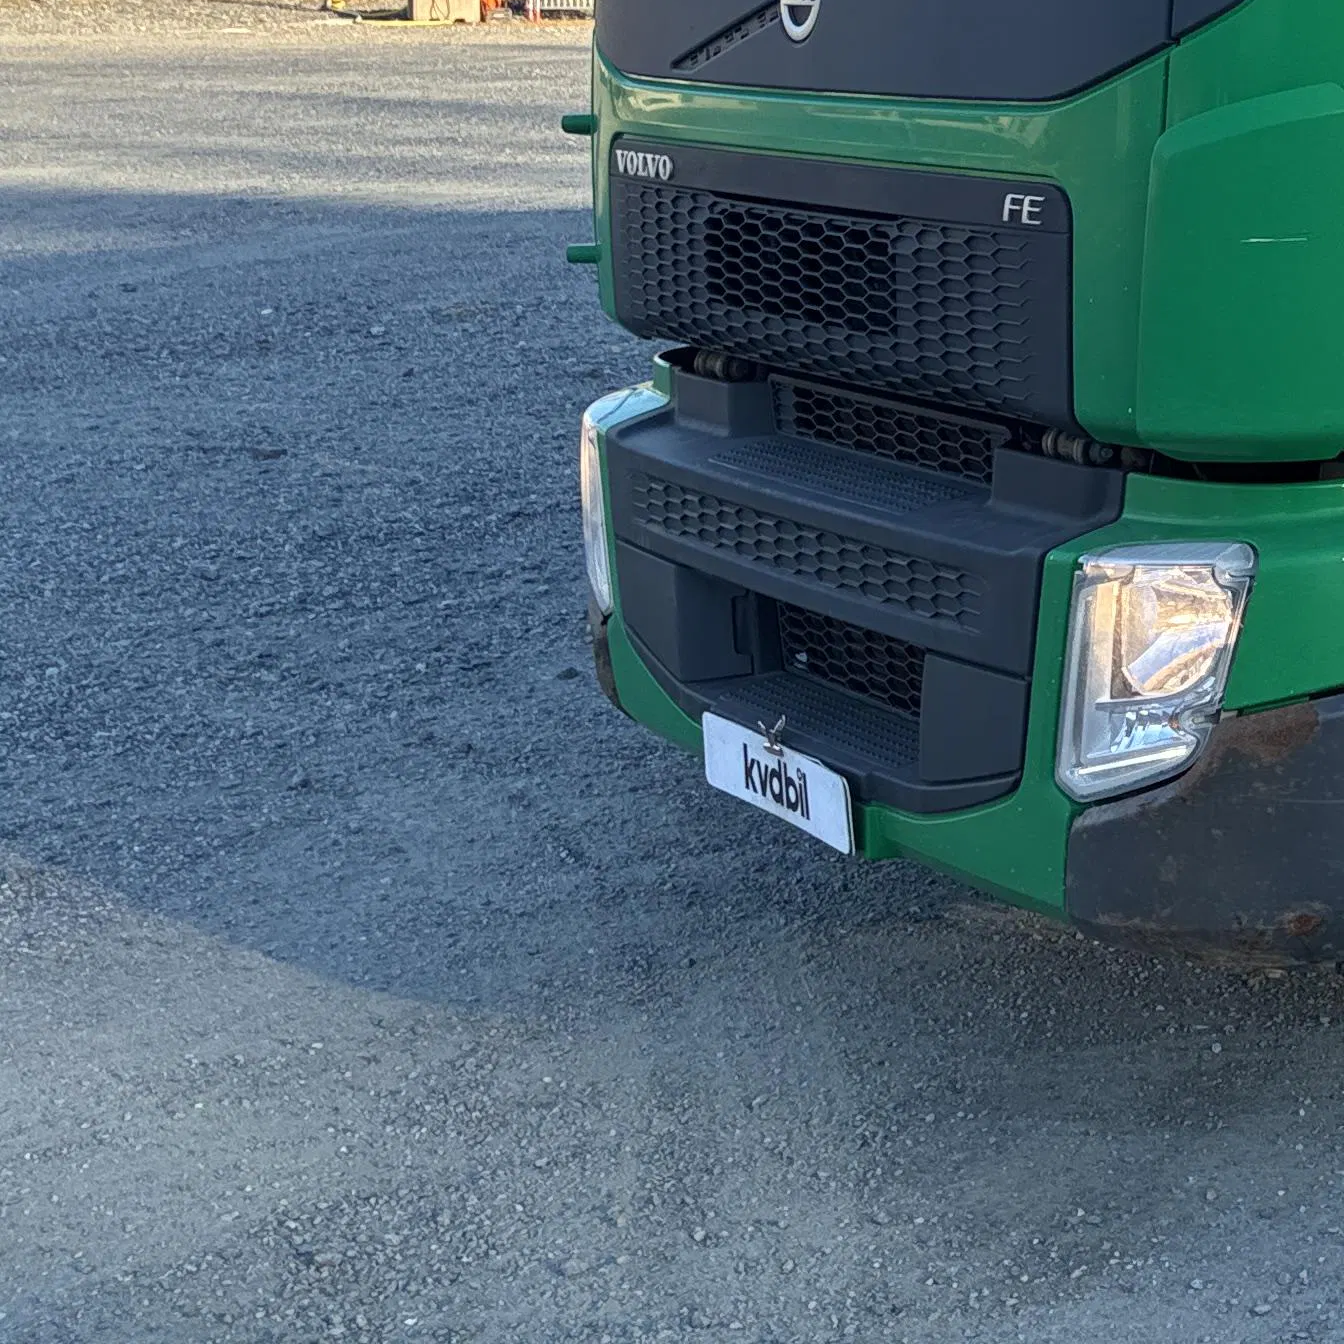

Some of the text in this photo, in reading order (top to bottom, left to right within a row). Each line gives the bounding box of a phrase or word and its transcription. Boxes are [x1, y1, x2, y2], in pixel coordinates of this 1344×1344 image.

[615, 149, 673, 181] VOLVO
[1002, 193, 1046, 225] FE
[742, 742, 811, 821] kvdbil
